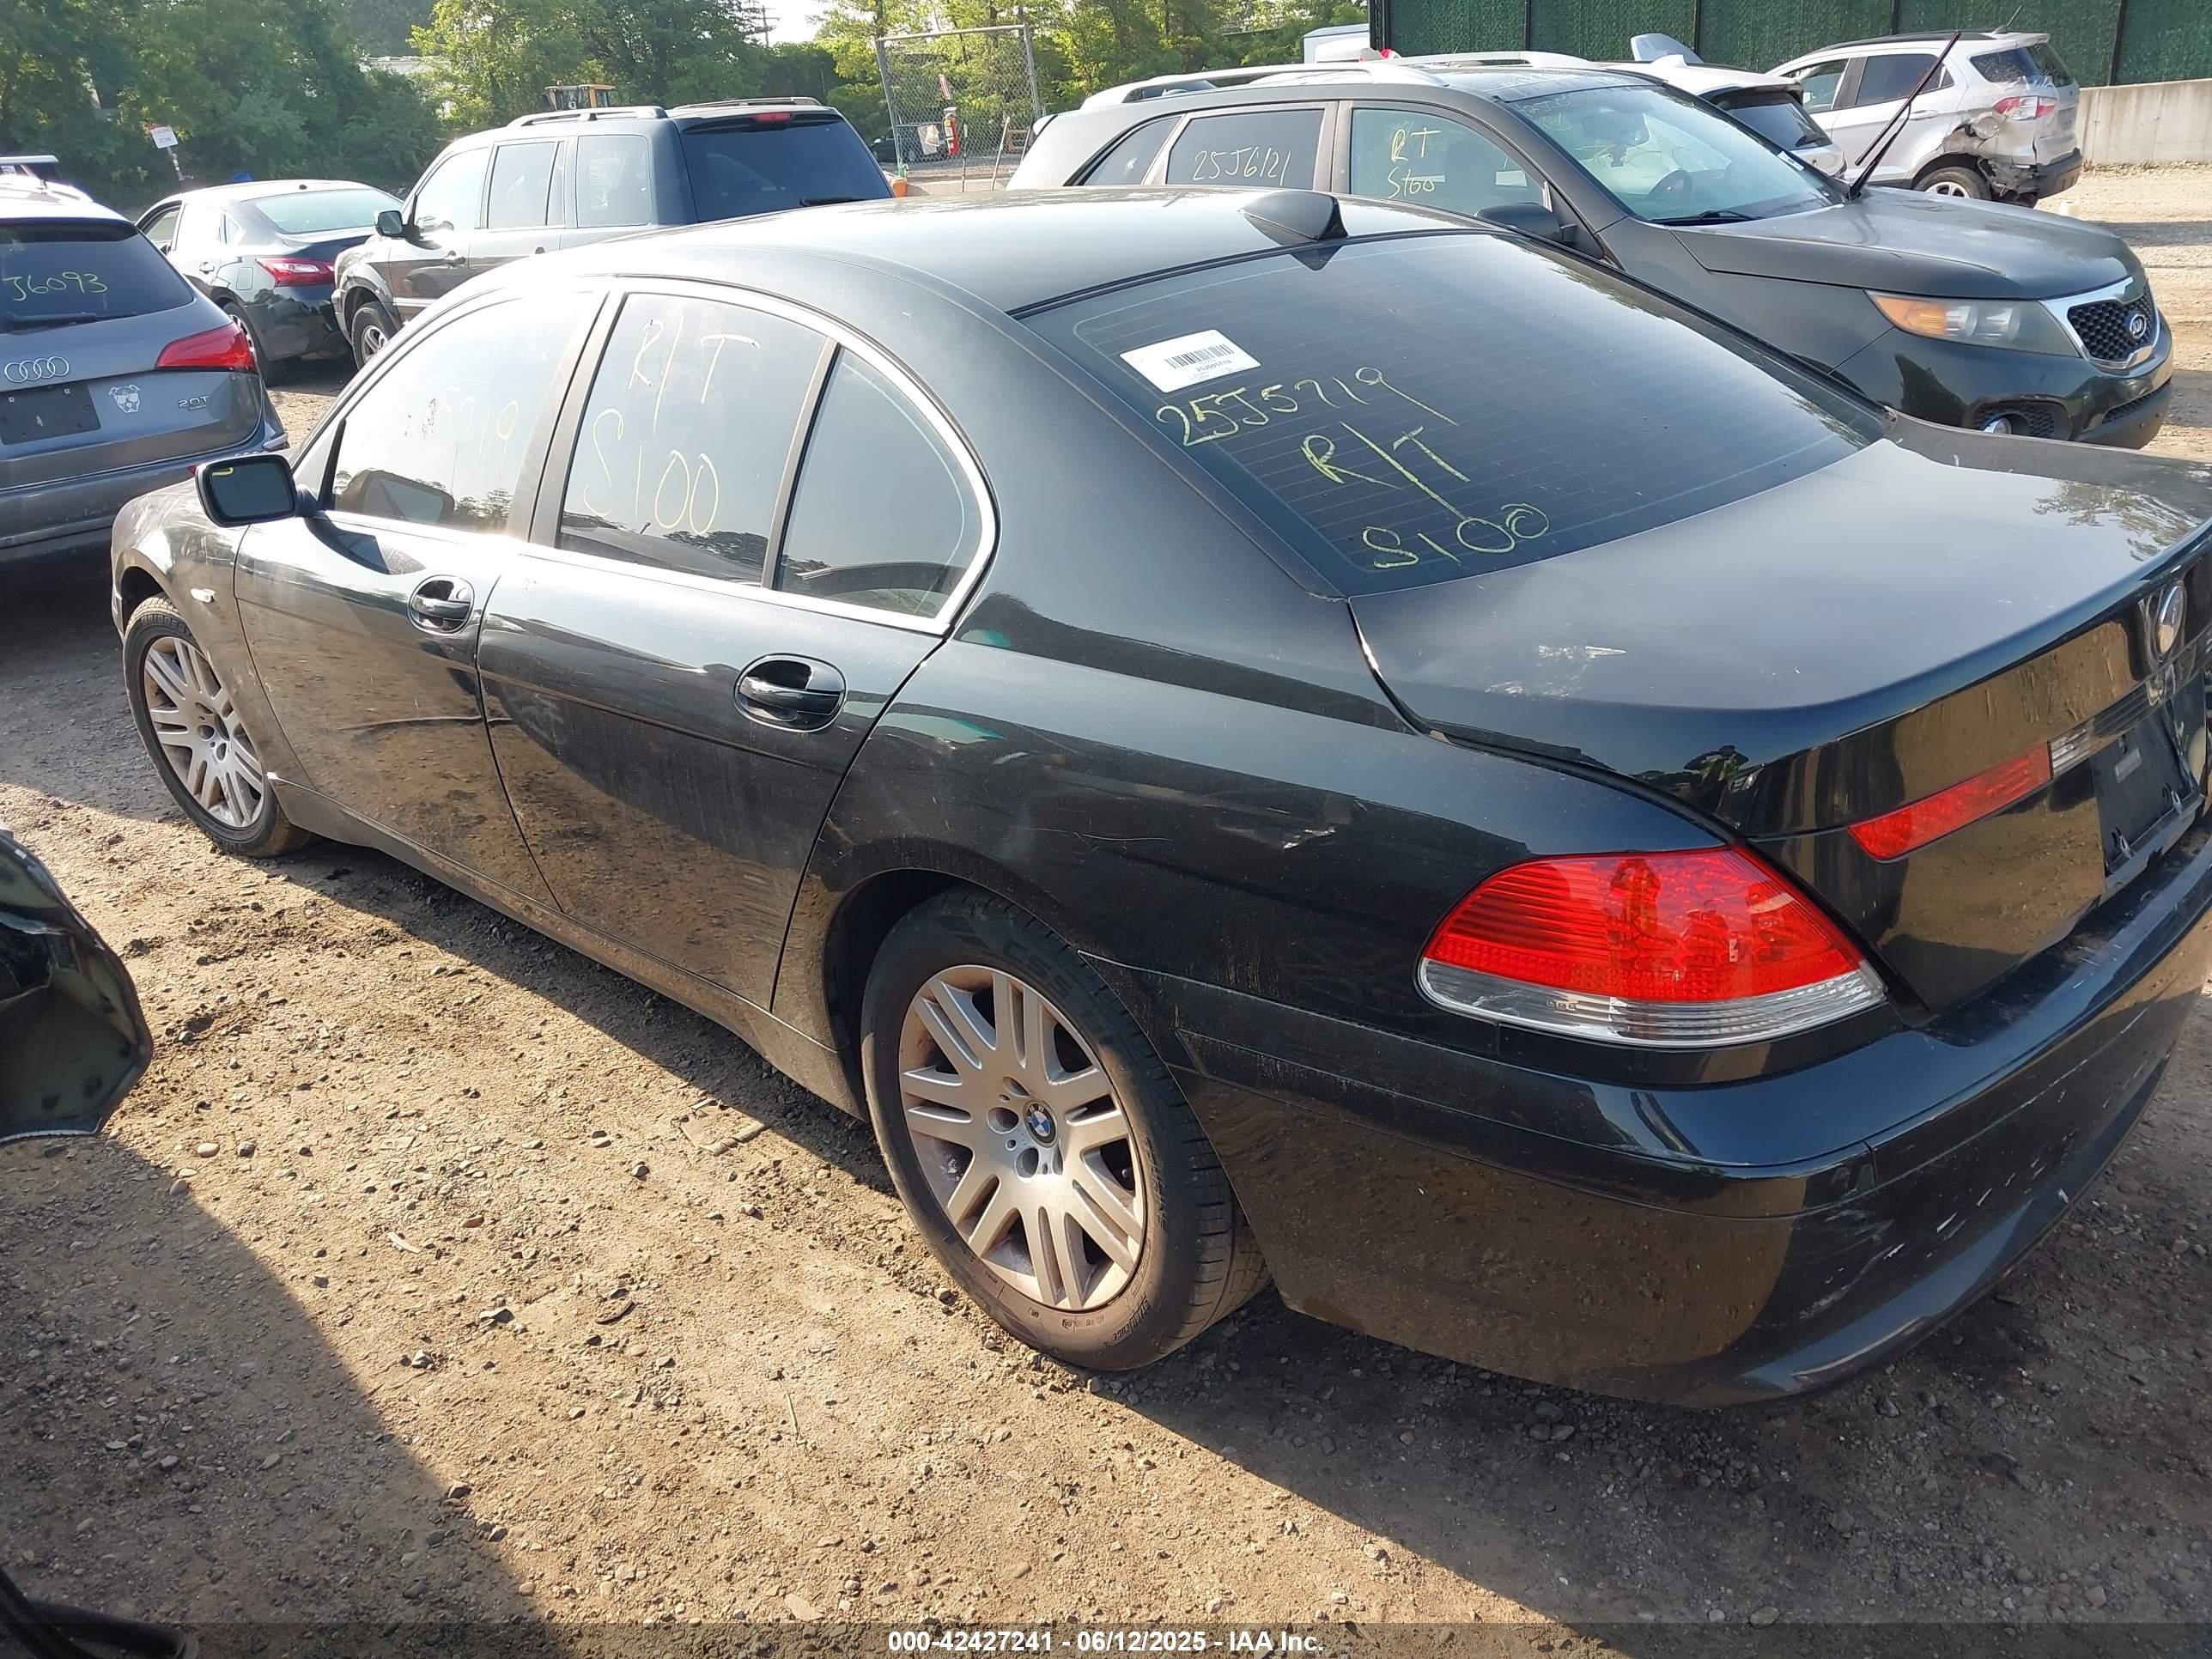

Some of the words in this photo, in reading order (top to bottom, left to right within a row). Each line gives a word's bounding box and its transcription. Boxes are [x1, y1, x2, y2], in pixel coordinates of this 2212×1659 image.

[1193, 146, 1291, 186] 25J6121
[2, 271, 108, 301] J6093
[1155, 366, 1461, 447] 25J5719
[583, 408, 719, 536] S100
[1300, 421, 1470, 520] R/T
[1362, 503, 1550, 568] S100
